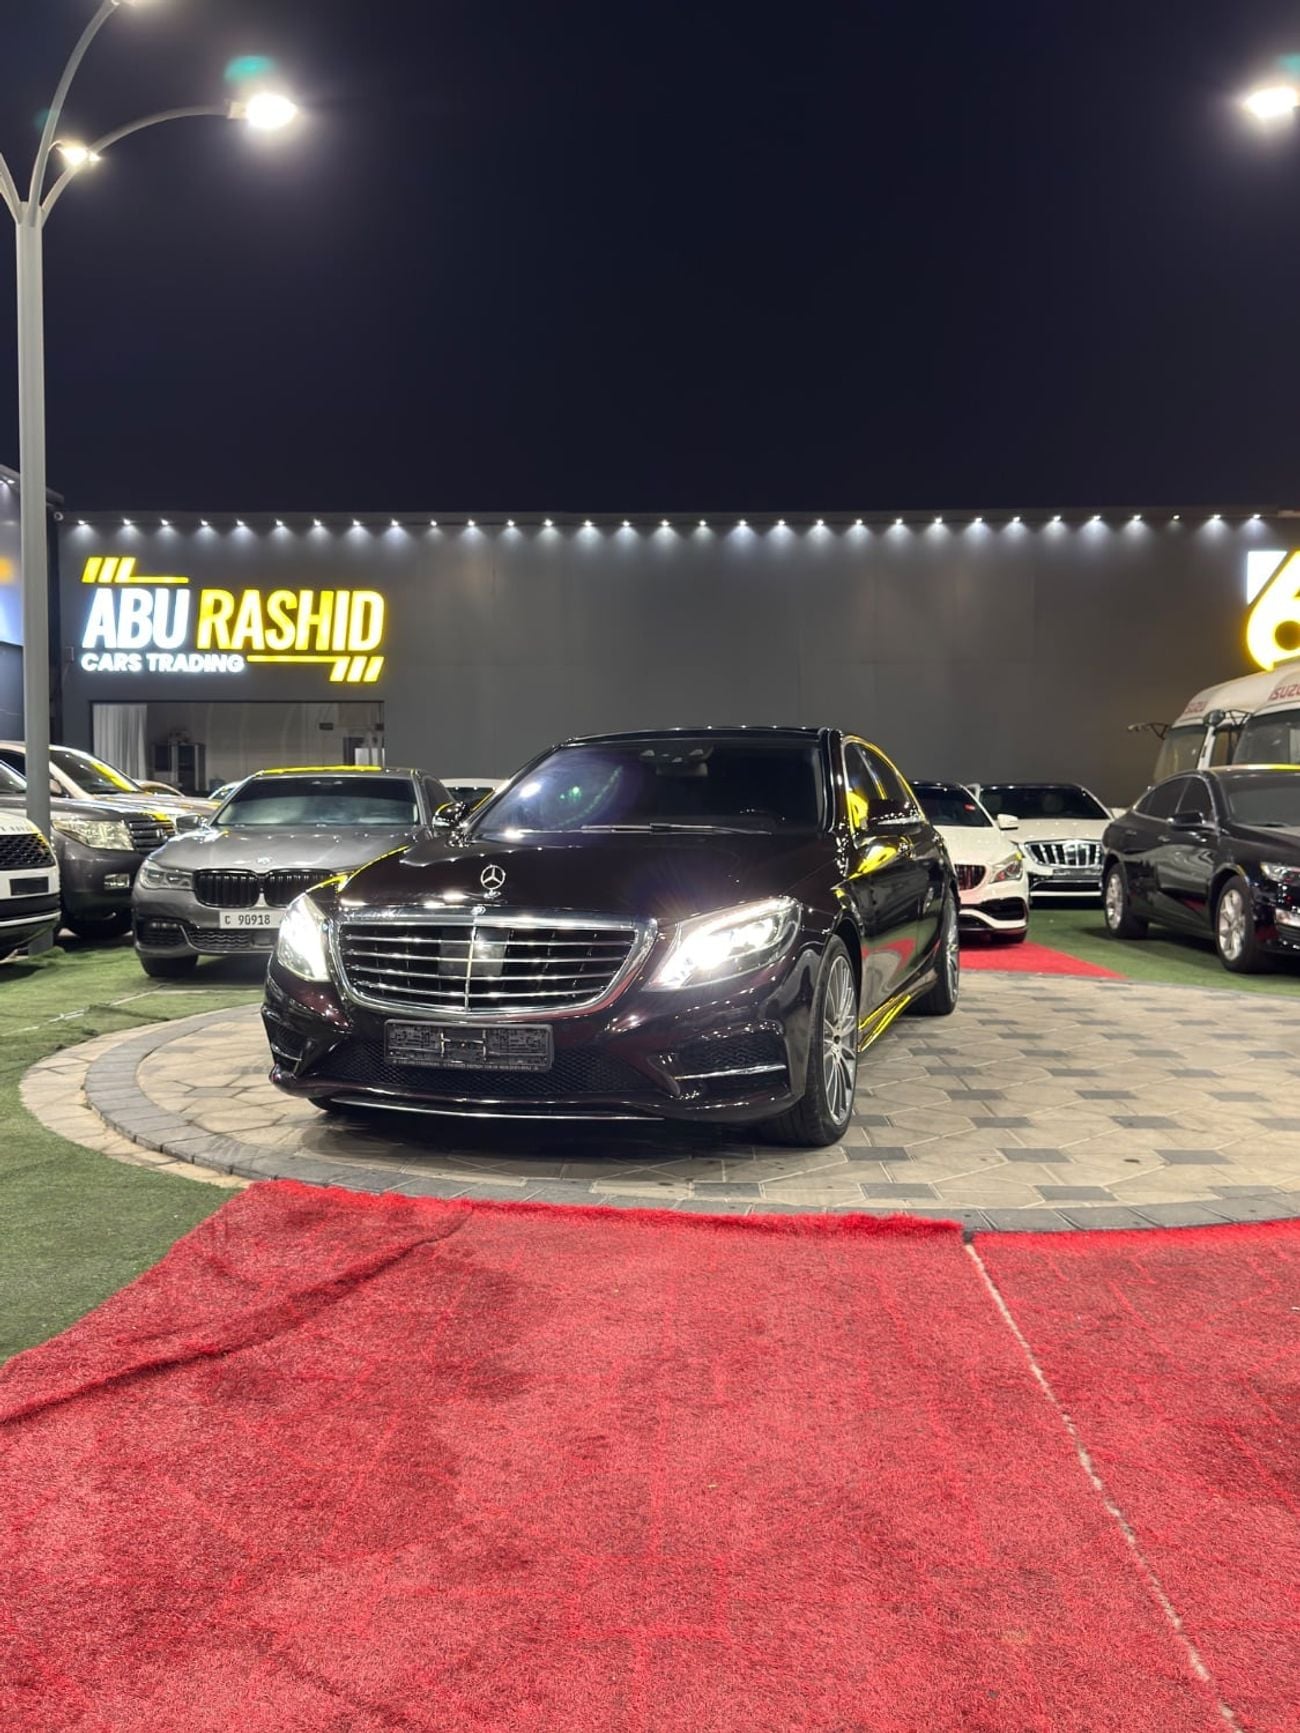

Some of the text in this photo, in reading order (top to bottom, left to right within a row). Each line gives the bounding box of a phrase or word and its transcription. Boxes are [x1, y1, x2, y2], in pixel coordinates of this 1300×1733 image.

[82, 588, 384, 650] ABU RASHID
[81, 653, 245, 673] CARS TRADING
[224, 914, 271, 925] C 90918
